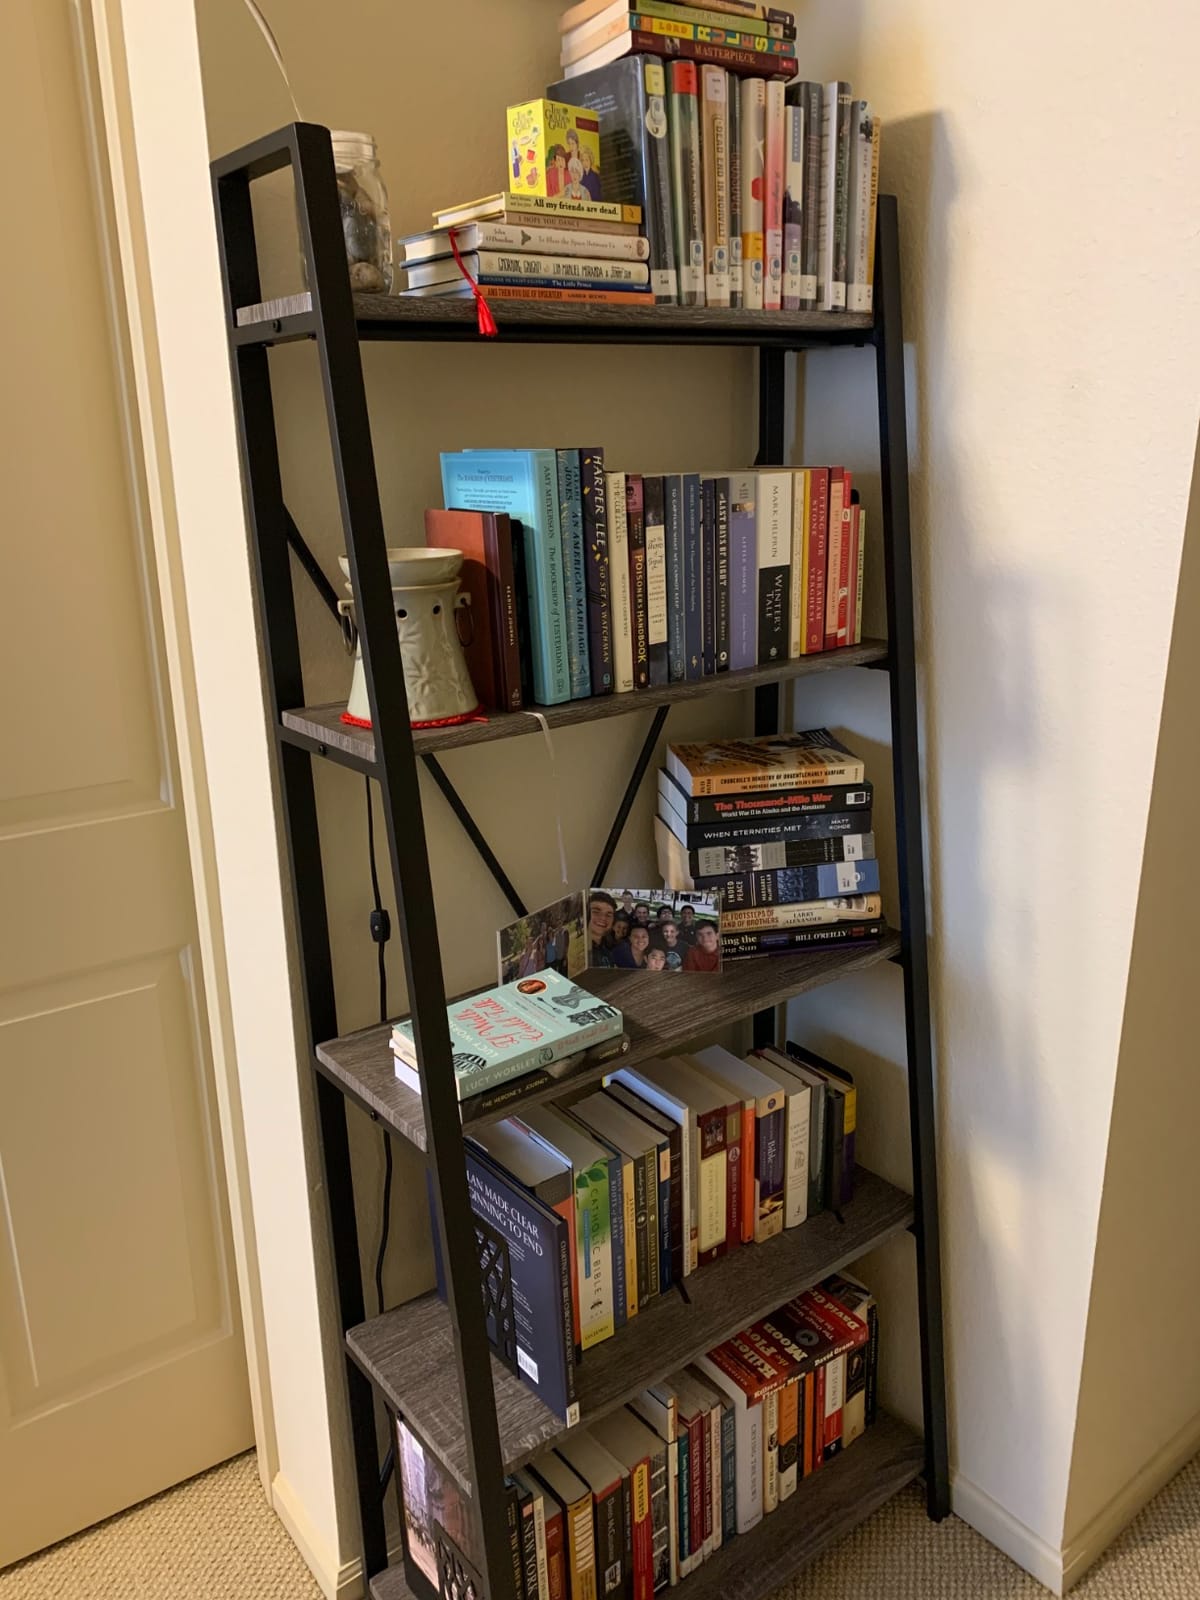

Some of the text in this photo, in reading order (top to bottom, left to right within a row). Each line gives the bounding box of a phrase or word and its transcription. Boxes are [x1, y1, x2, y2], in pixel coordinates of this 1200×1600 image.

[694, 43, 756, 64] MASTERPIECE
[716, 126, 724, 153] DEAD
[716, 157, 725, 178] END
[534, 198, 545, 208] All
[546, 201, 558, 211] my
[559, 201, 586, 212] friends
[586, 205, 598, 213] are
[599, 204, 619, 216] dead.
[564, 466, 573, 501] JONES
[672, 488, 678, 498] TO
[543, 466, 556, 539] AMY MEYERSON
[592, 454, 606, 548] HARPER LEE
[719, 500, 727, 521] LAST
[770, 485, 780, 558] MARK HELPRIN
[817, 478, 826, 556] CUTTING FOR
[572, 510, 587, 656] AN AMERICAN MARRIAGE
[720, 559, 728, 586] NIGHT
[600, 581, 608, 598] SET
[808, 566, 816, 622] VERGHESE
[548, 546, 564, 674] The BOOKSHOP of YESTERDAYS
[765, 590, 774, 618] TALE
[772, 574, 783, 633] WINTER'S
[601, 611, 610, 664] WATCHMAN
[637, 610, 648, 664] HANDBOOK
[751, 774, 775, 782] MINISTRY
[824, 769, 846, 777] WARFARE
[714, 793, 833, 812] The Thousand-Mile War
[721, 810, 739, 818] World
[762, 807, 780, 815] Alaska
[704, 824, 802, 840] WHEN ETERNITIES MET
[727, 880, 736, 903] ENDED
[736, 880, 744, 902] PEACE
[730, 909, 774, 920] FOOTSTEPS OF
[746, 917, 779, 926] BROTHERS
[784, 916, 822, 925] ALEXANDER
[742, 935, 758, 944] the
[795, 930, 848, 942] BILL O'REILLY
[453, 1008, 490, 1037] Walls
[472, 996, 544, 1043] Could Talk
[476, 1041, 499, 1058] LUCY
[465, 1057, 538, 1092] LUCY WORSLEY
[482, 1077, 548, 1108] THE HEROINE'S JOURNEY
[767, 1140, 776, 1164] Bible
[610, 1180, 618, 1208] ROOTS
[647, 1156, 656, 1206] CATHOLICISM
[466, 1170, 540, 1240] LAN MADE CLEAR
[507, 1218, 544, 1256] TO END
[590, 1188, 603, 1297] CATHOLIC BIBLE
[560, 1240, 568, 1274] CHARTING
[824, 1303, 860, 1330] David
[762, 1322, 808, 1362] Moon
[814, 1341, 854, 1366] David Grann
[730, 1336, 778, 1380] Killer
[775, 1354, 788, 1367] the
[754, 1382, 778, 1398] Killers
[787, 1372, 806, 1385] Moon
[524, 1520, 538, 1596] NEW YORK
